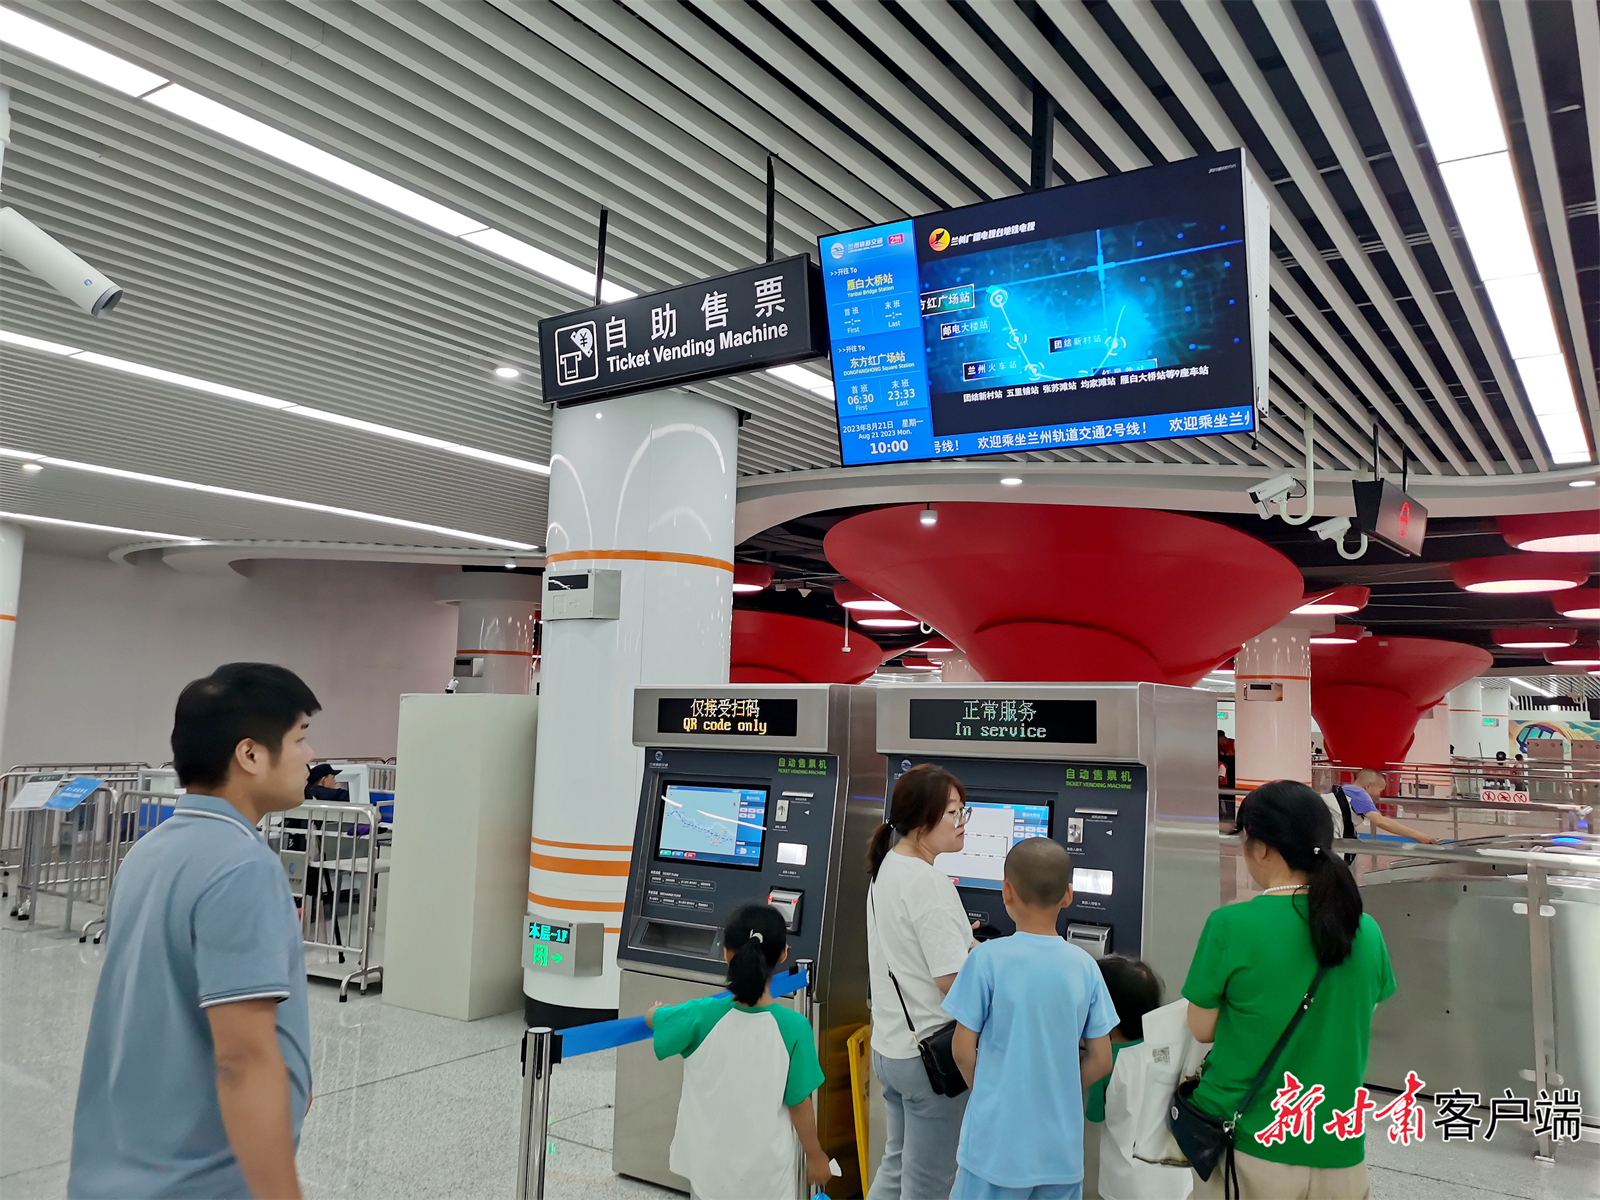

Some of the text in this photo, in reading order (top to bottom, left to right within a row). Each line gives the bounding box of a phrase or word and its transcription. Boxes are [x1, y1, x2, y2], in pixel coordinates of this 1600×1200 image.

[846, 272, 893, 291] 雁白大桥站
[605, 275, 786, 352] 自助售票
[843, 307, 859, 316] 首班
[847, 326, 860, 334] First
[888, 320, 901, 328] Last
[942, 319, 989, 337] 邮电大楼站
[606, 321, 789, 373] Ticket Vending Machine
[1054, 334, 1102, 350] 团结新村站
[850, 350, 906, 369] 东方红广场站
[967, 360, 1017, 375] 兰州火车站
[851, 383, 868, 394] 首班
[887, 388, 916, 401] 23:33
[963, 389, 1003, 403] 团结新村站
[847, 393, 874, 405] 06:30
[896, 399, 909, 407] Last
[842, 418, 924, 434] 2023年8月21日 星期一
[858, 432, 871, 440] Aug
[880, 430, 896, 438] 2023
[977, 421, 1147, 450] 欢迎乘坐兰州轨道交通2号线！
[870, 439, 909, 455] 10:00
[690, 698, 760, 718] 仅接受扫码
[962, 700, 1037, 723] 正常服务
[683, 717, 768, 735] QR code only
[955, 722, 1047, 738] In service
[778, 757, 827, 770] 自动售票机
[1066, 768, 1132, 782] 自动售票机
